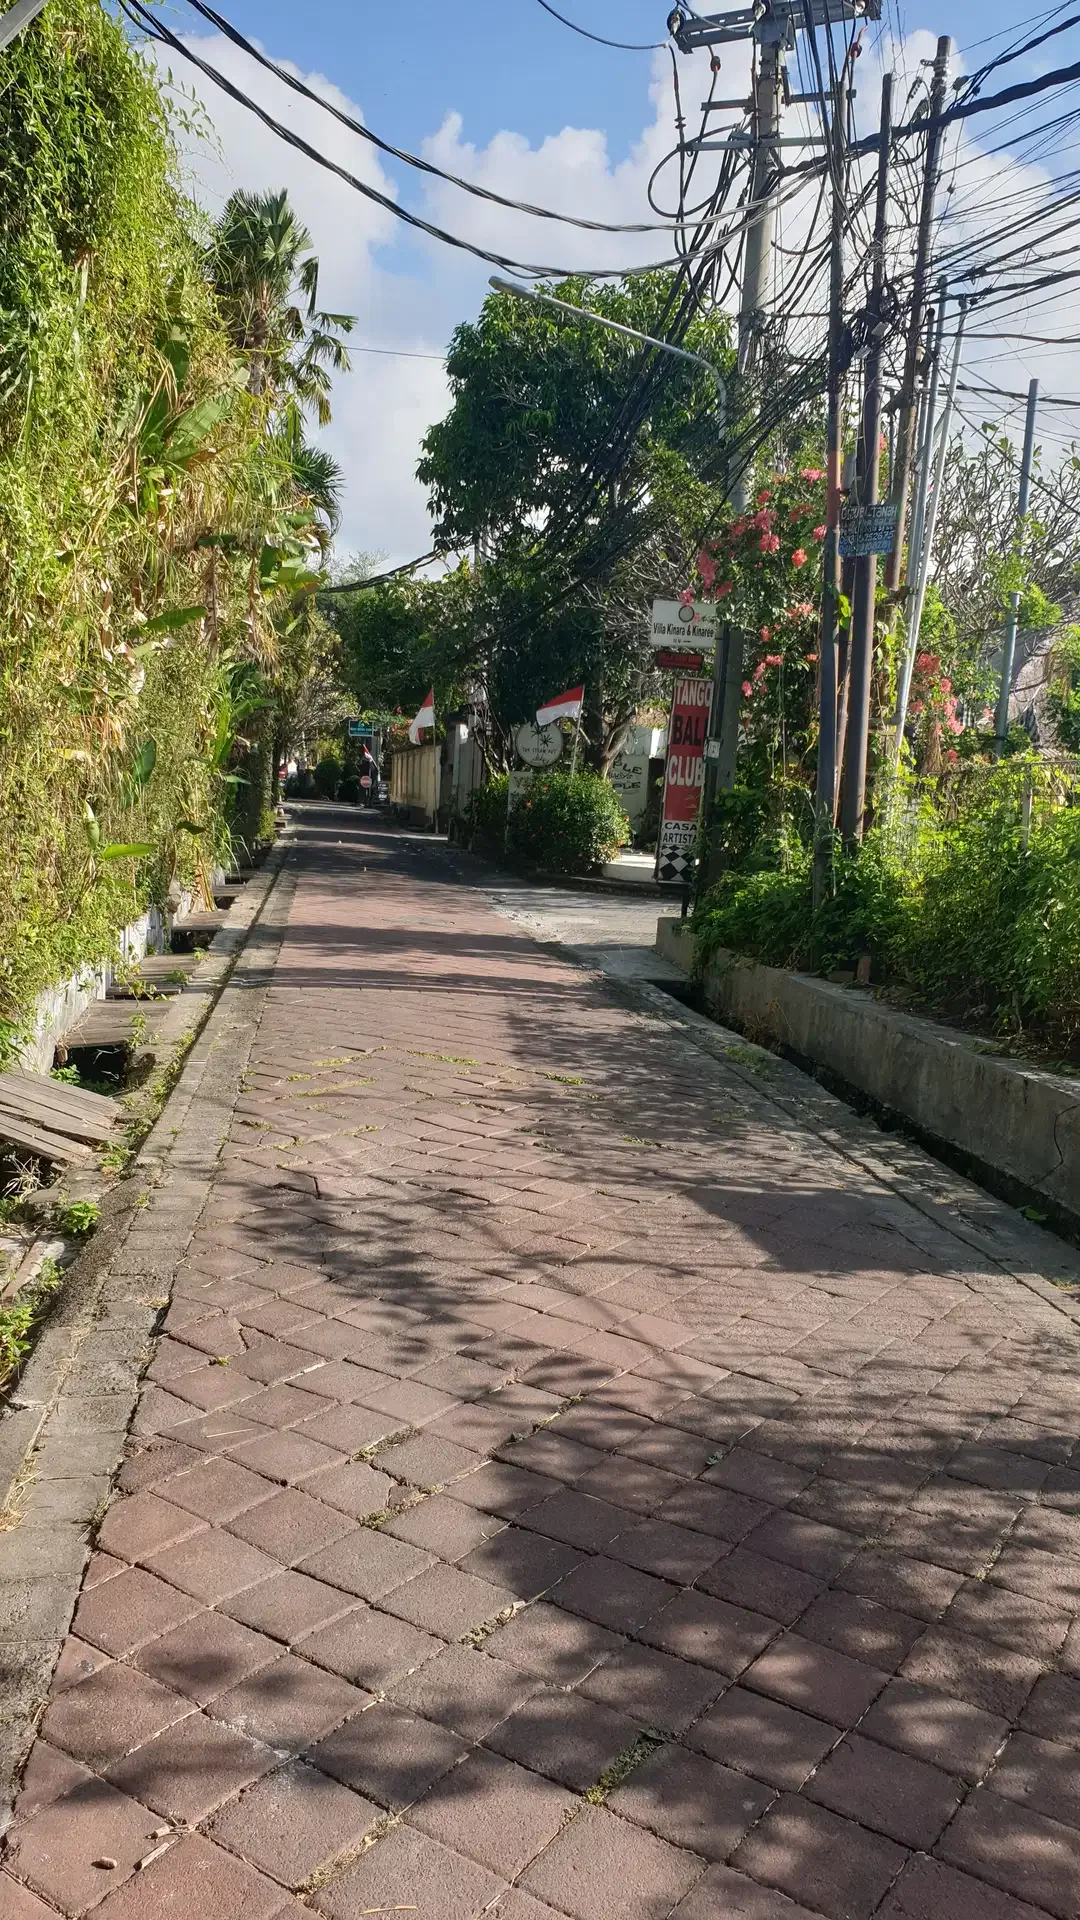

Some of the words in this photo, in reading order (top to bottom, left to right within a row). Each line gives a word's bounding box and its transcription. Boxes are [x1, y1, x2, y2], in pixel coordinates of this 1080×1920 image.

[653, 622, 666, 635] Villa
[666, 623, 686, 636] Kinara
[686, 625, 691, 636] &
[692, 625, 714, 638] Kinaree
[676, 681, 714, 708] TANGO
[668, 755, 706, 787] CLUB
[664, 822, 697, 832] CASA
